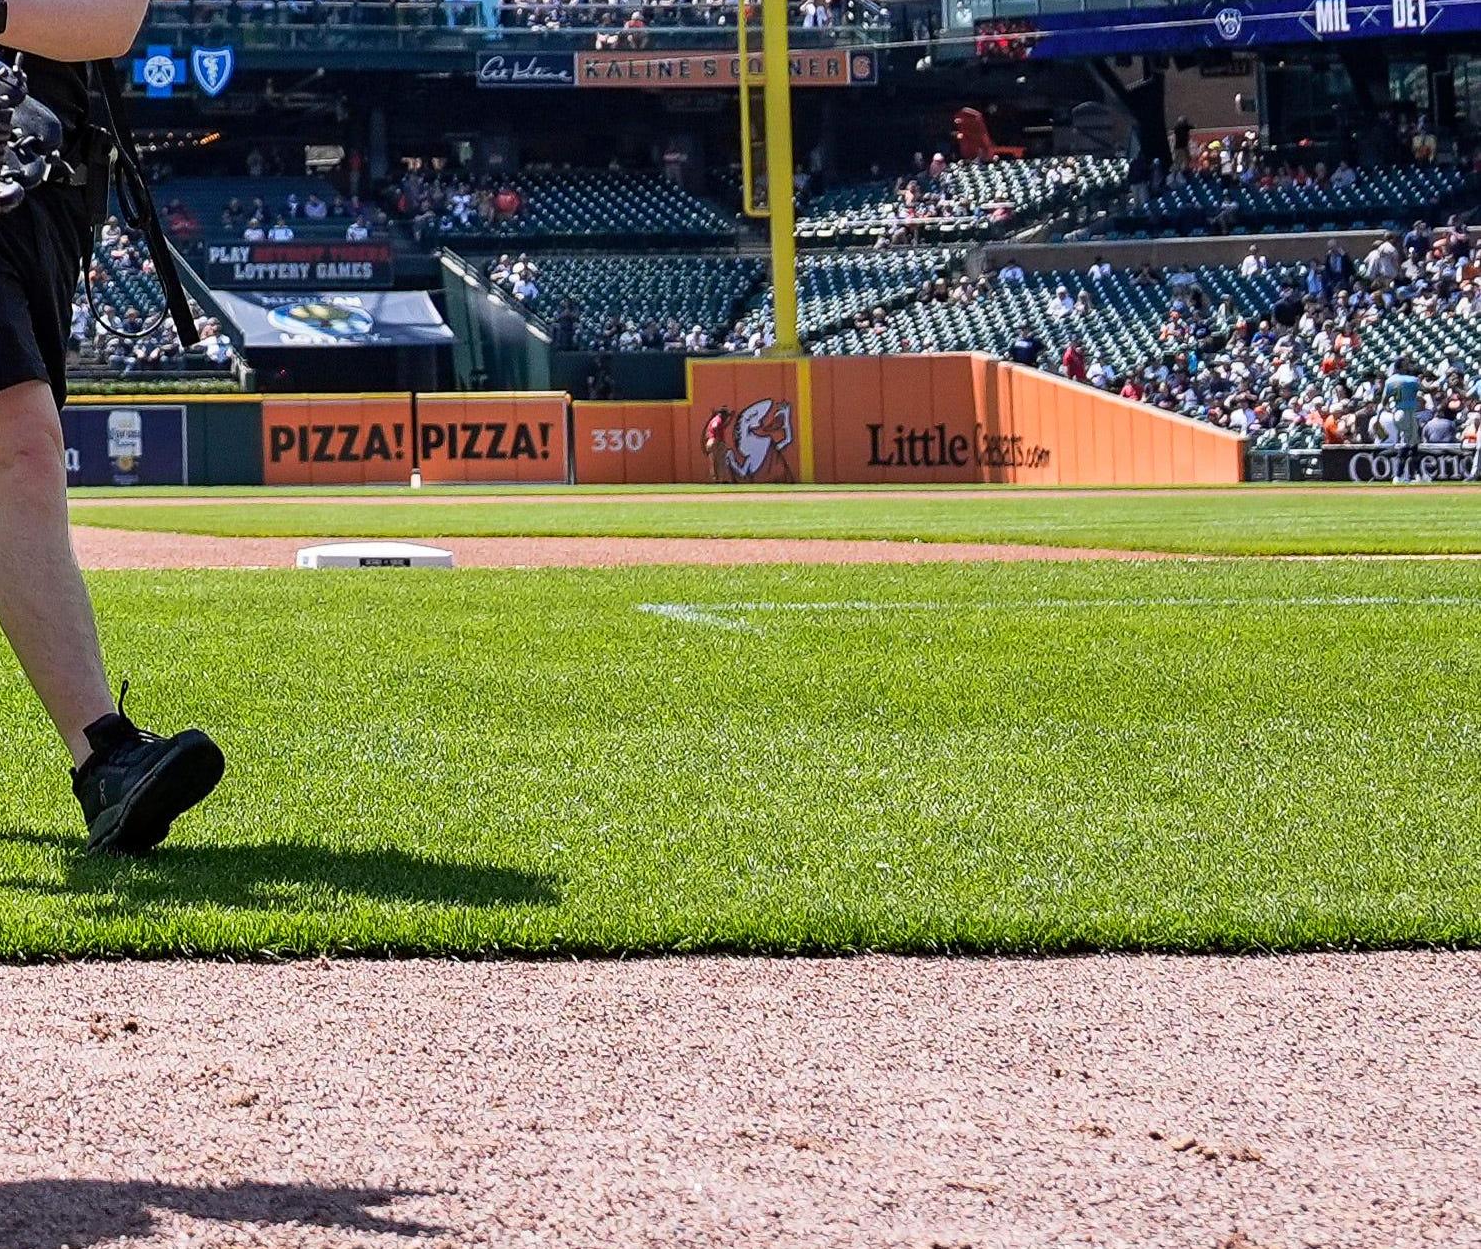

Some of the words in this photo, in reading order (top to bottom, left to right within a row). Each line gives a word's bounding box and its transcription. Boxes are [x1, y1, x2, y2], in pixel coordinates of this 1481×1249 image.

[730, 57, 840, 79] CONER
[209, 246, 250, 263] PLAY
[233, 262, 310, 279] LOTTERY
[316, 262, 373, 279] GAMES
[270, 422, 405, 463] PIZZA!
[421, 421, 553, 461] PIZZA!
[866, 422, 970, 468] Little
